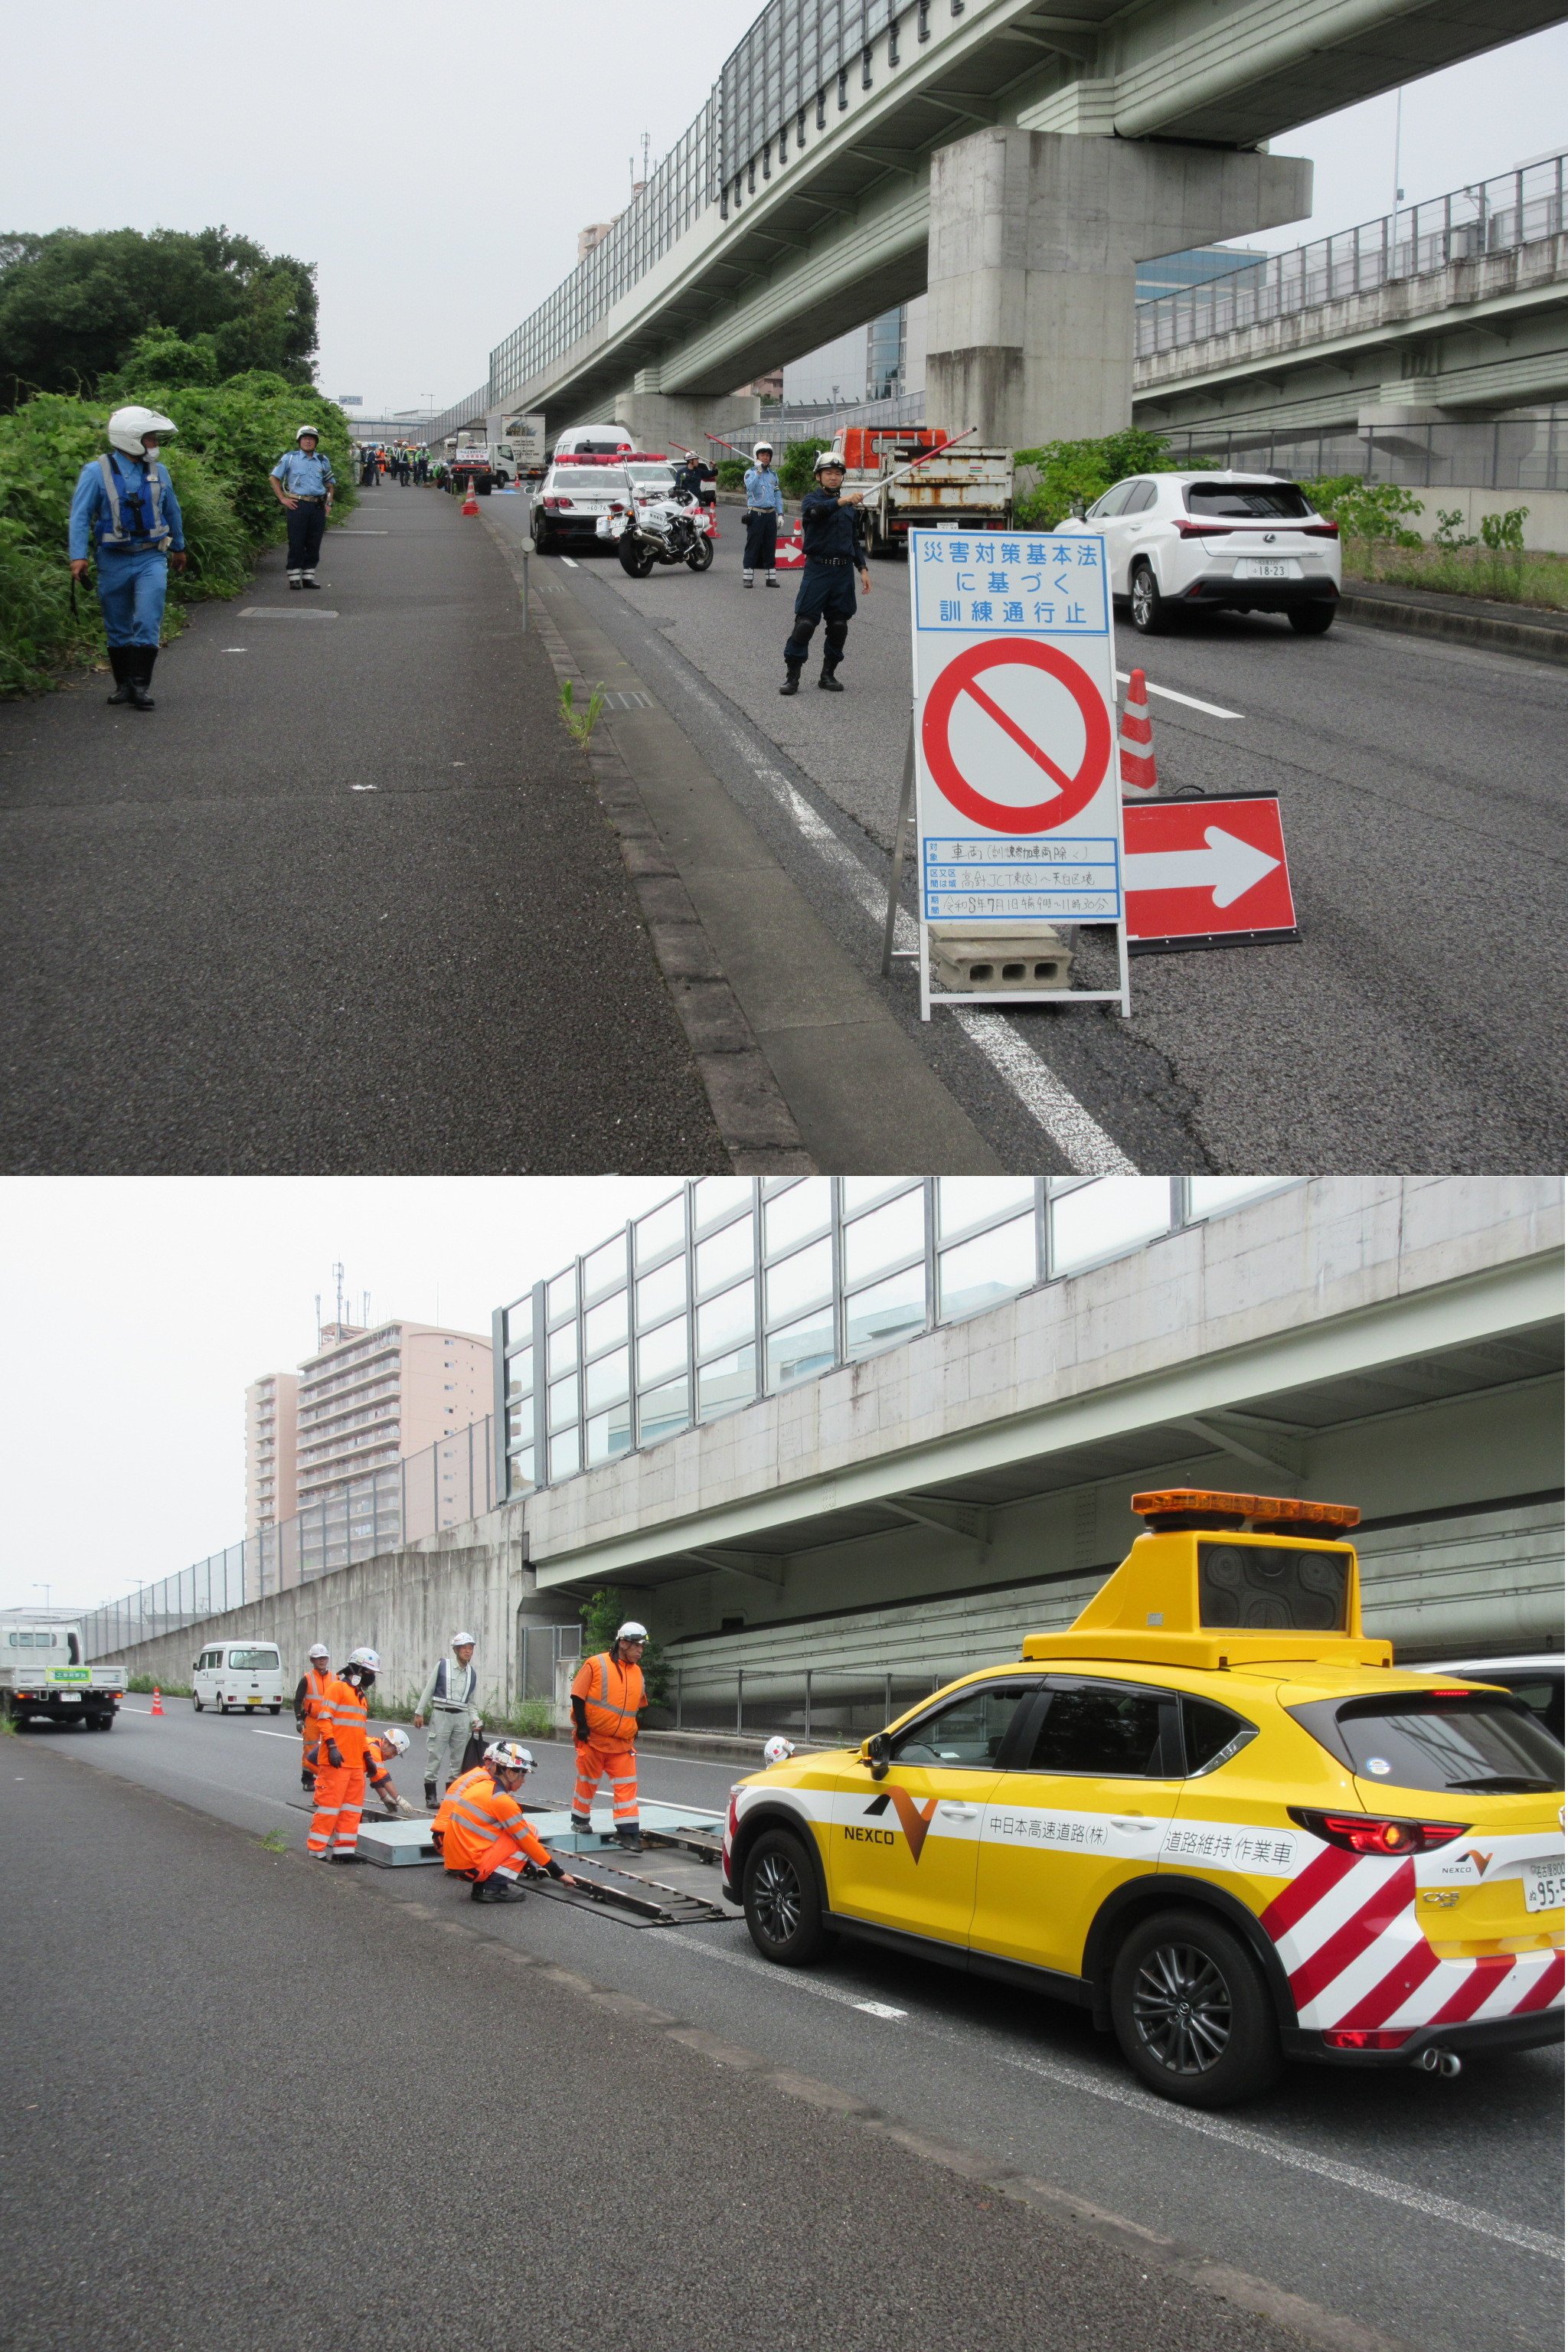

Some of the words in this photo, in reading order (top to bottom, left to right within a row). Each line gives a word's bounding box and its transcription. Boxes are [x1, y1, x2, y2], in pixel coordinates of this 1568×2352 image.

[923, 541, 1098, 567] 災害対策基本法
[957, 571, 1070, 595] に基づく
[939, 599, 1086, 624] 訓練通行止
[930, 843, 938, 861] 対象
[931, 896, 939, 914] 期間
[844, 1827, 894, 1845] NEXCO
[990, 1818, 1109, 1846] 中日本高速道路(株)
[1165, 1831, 1293, 1865] 道路維持作業車
[1423, 1891, 1460, 1903] CX-5
